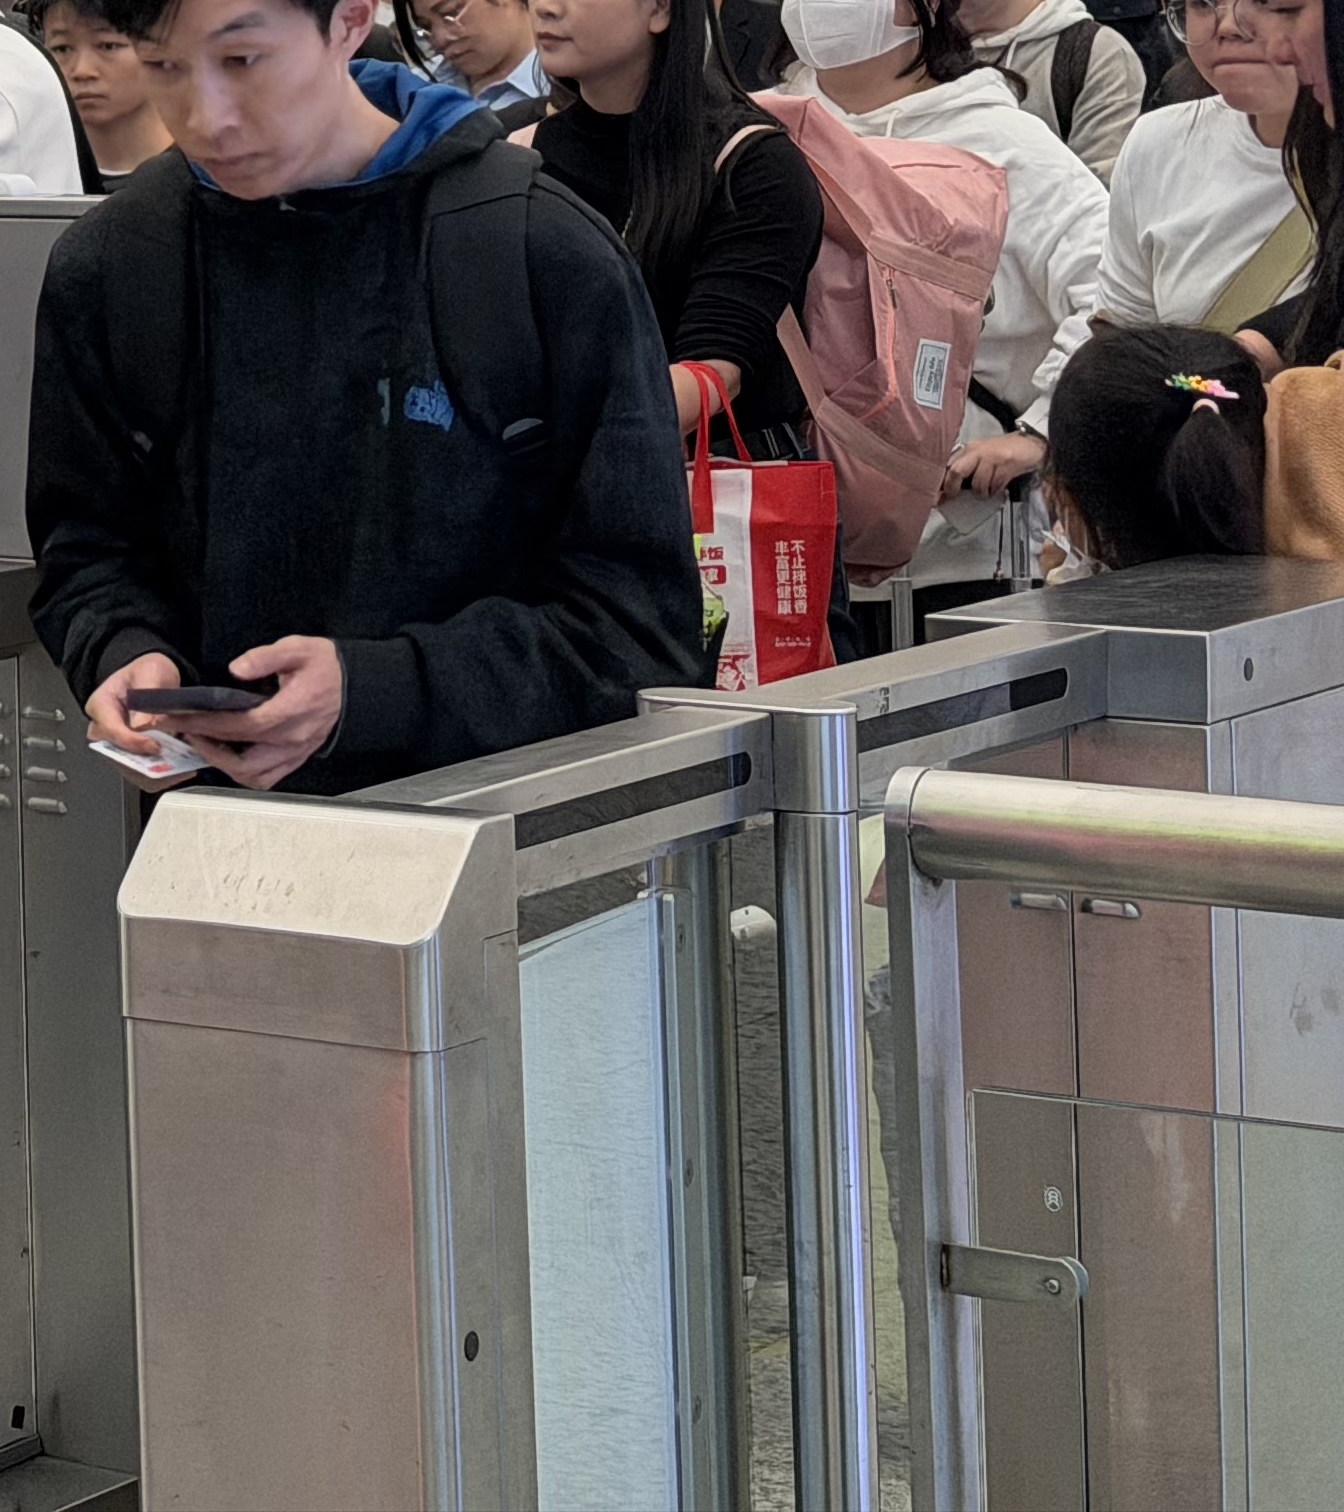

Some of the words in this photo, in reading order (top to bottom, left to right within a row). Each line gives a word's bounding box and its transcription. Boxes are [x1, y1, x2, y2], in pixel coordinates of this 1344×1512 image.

[790, 540, 808, 615] 不止拌饭香
